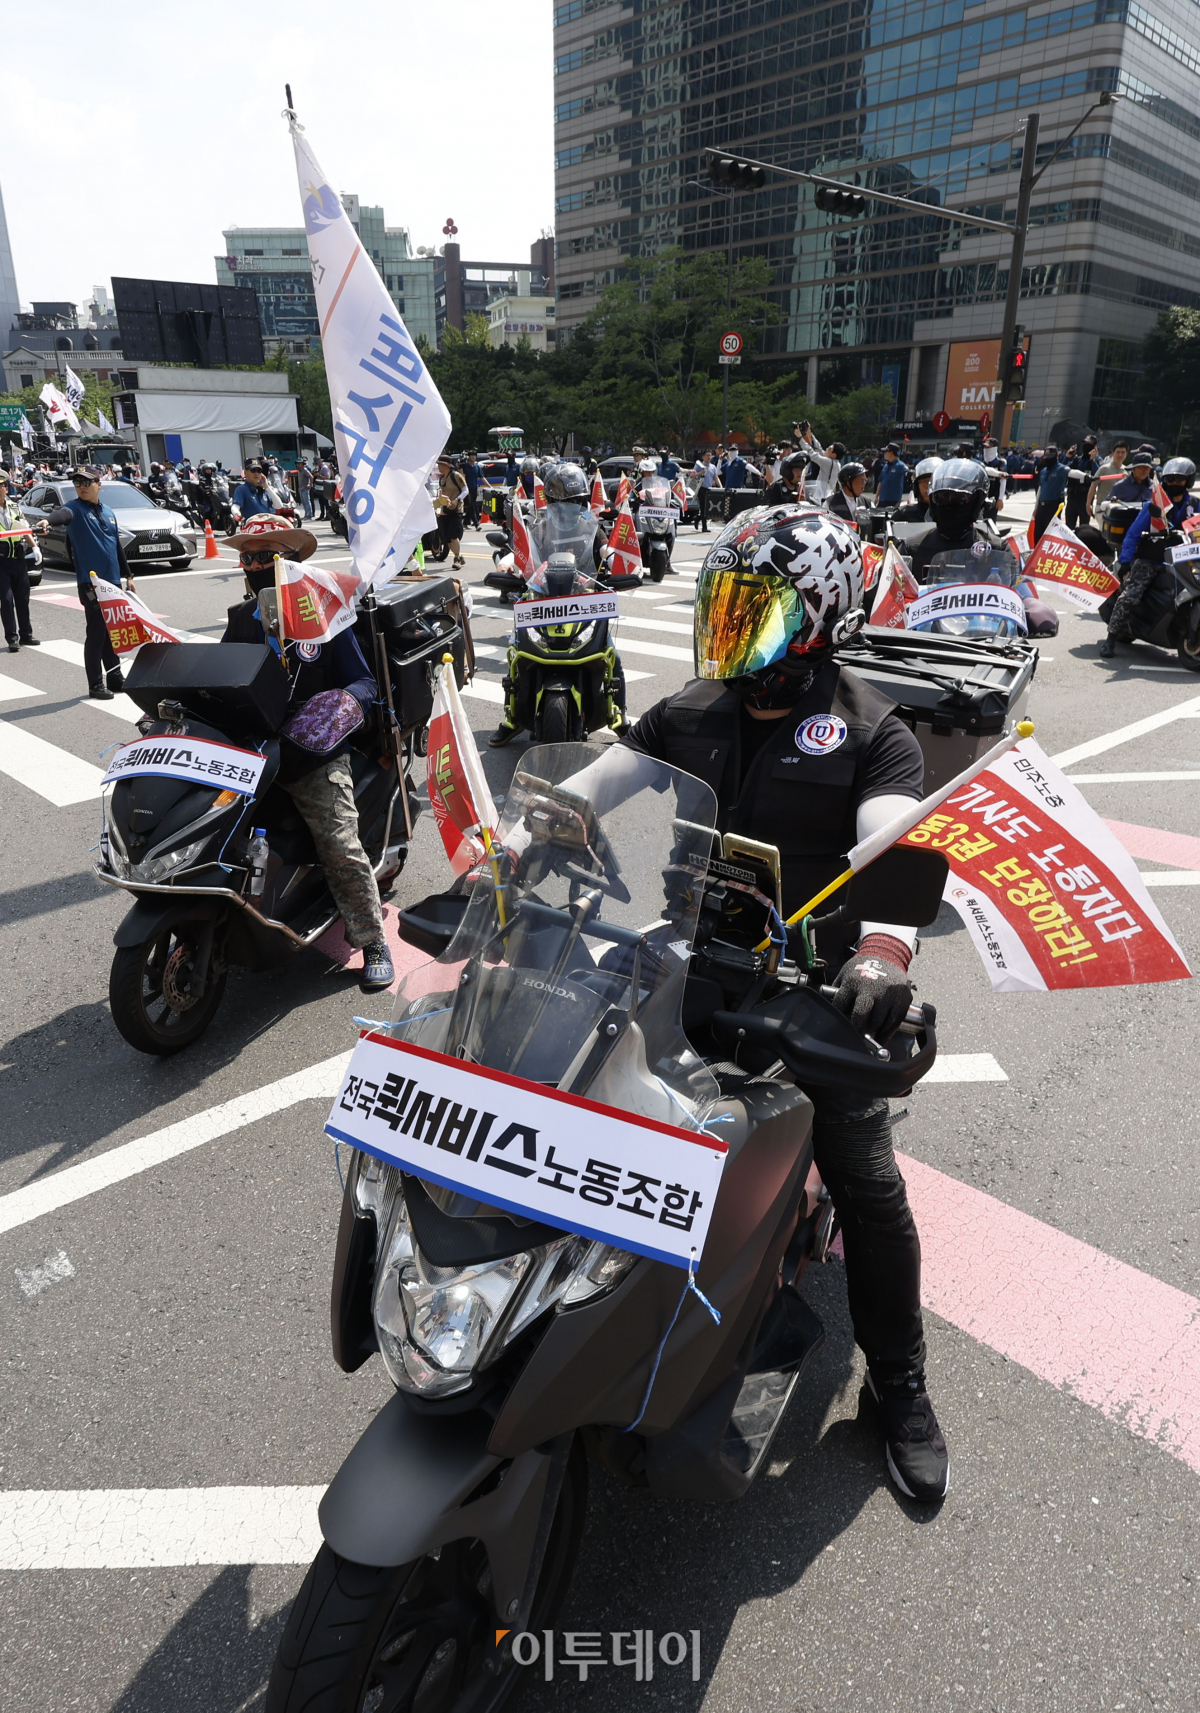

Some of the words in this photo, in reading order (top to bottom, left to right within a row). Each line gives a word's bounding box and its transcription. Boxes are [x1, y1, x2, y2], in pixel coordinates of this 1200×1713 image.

[725, 338, 738, 350] 50
[708, 549, 735, 566] Arai
[1041, 540, 1077, 561] 퀵기사도
[1034, 557, 1069, 578] 노동3권
[1067, 565, 1113, 591] 보장하라!
[297, 592, 320, 625] 퀵
[516, 602, 617, 623] 전국퀵서비스노동조합
[107, 748, 256, 785] 전국퀵서비스노동조합
[1012, 758, 1067, 809] 민주노총
[133, 808, 154, 816] HONDA
[1027, 843, 1143, 944] 노동자다
[978, 857, 1099, 969] 보장하라!
[965, 898, 1008, 970] 퀵서비스노동조합
[522, 978, 578, 1002] HONDA
[339, 1072, 704, 1233] 전국퀵서비스노동조합
